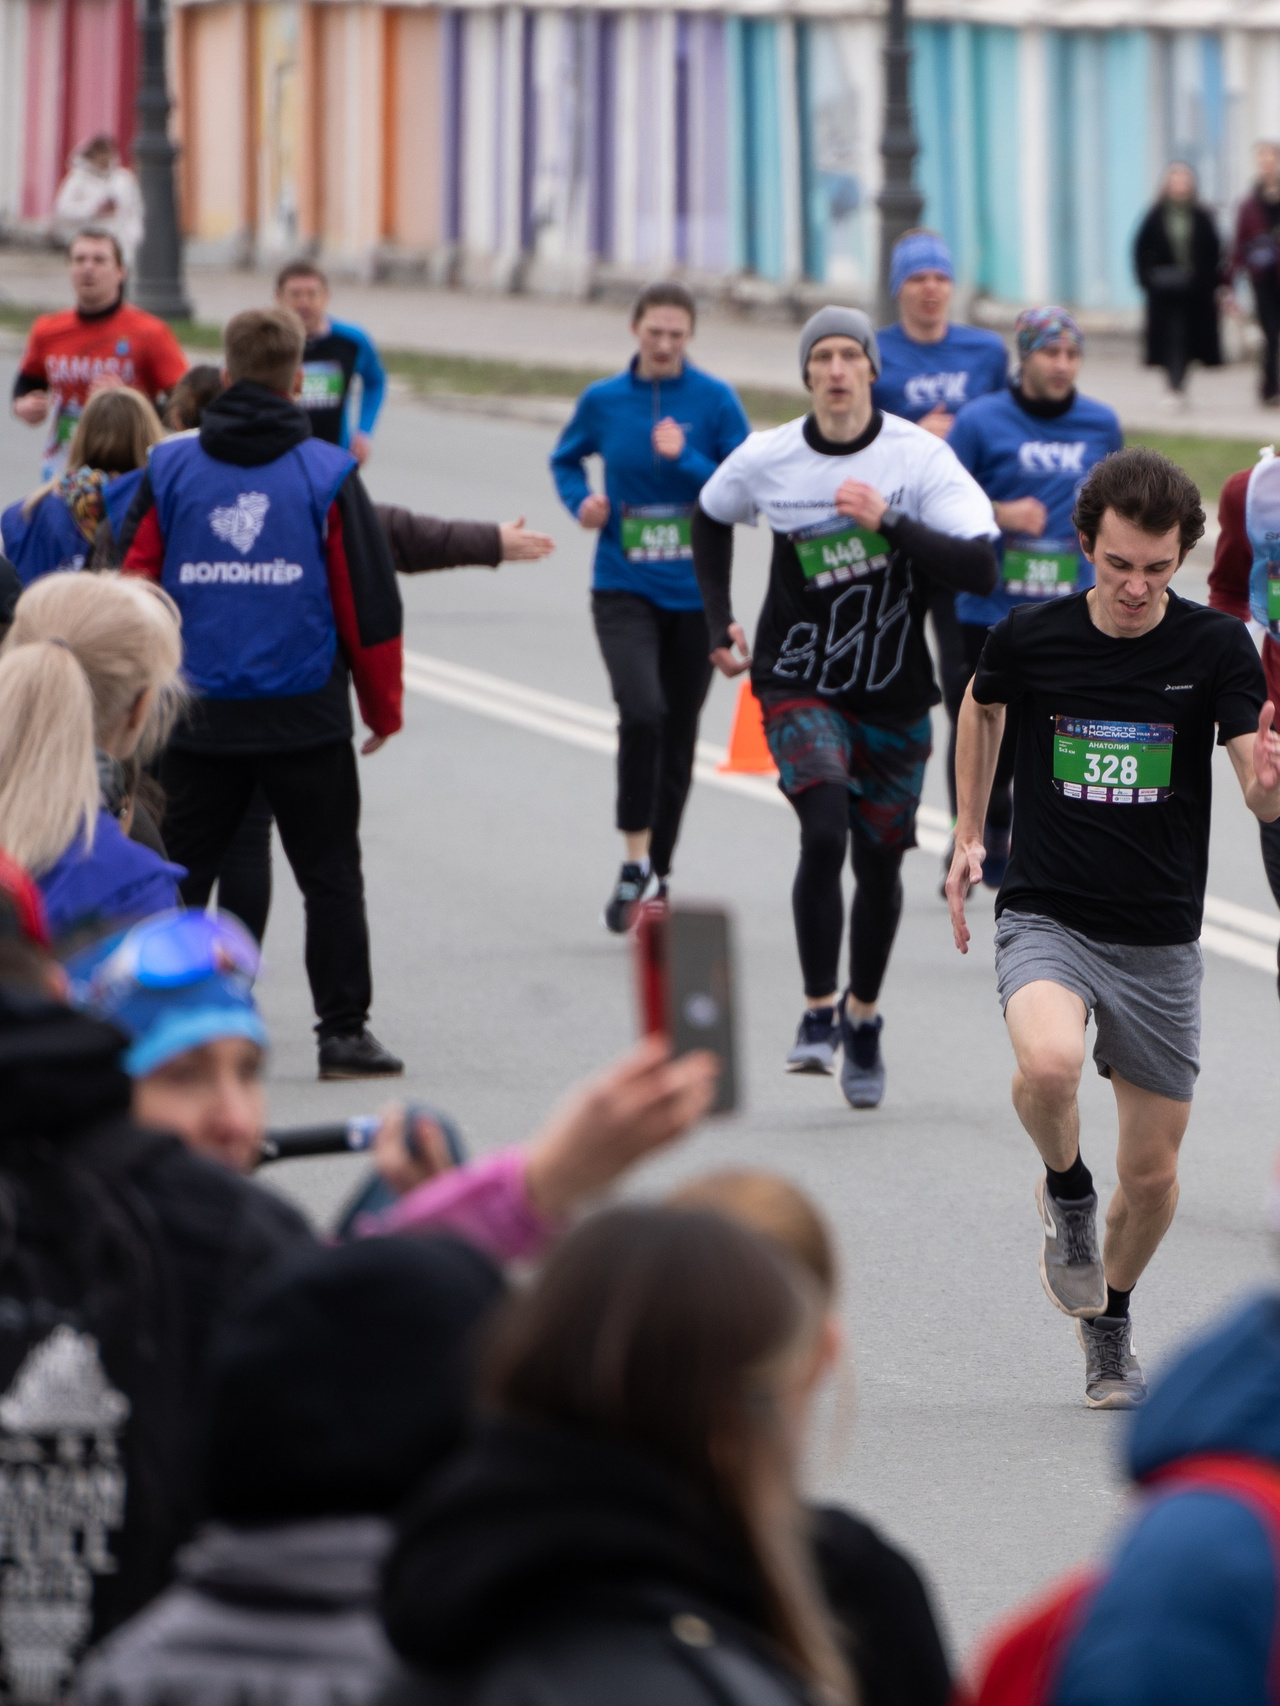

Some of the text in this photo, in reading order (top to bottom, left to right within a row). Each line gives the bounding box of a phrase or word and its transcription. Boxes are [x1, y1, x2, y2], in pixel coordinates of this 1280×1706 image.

[822, 537, 867, 567] 448
[179, 558, 303, 585] ВОЛОНТЁР
[1088, 730, 1136, 739] КОСМОС
[1096, 725, 1137, 733] ПРОСТО
[1088, 741, 1130, 751] АНАТОЛИЙ
[1084, 753, 1138, 785] 328
